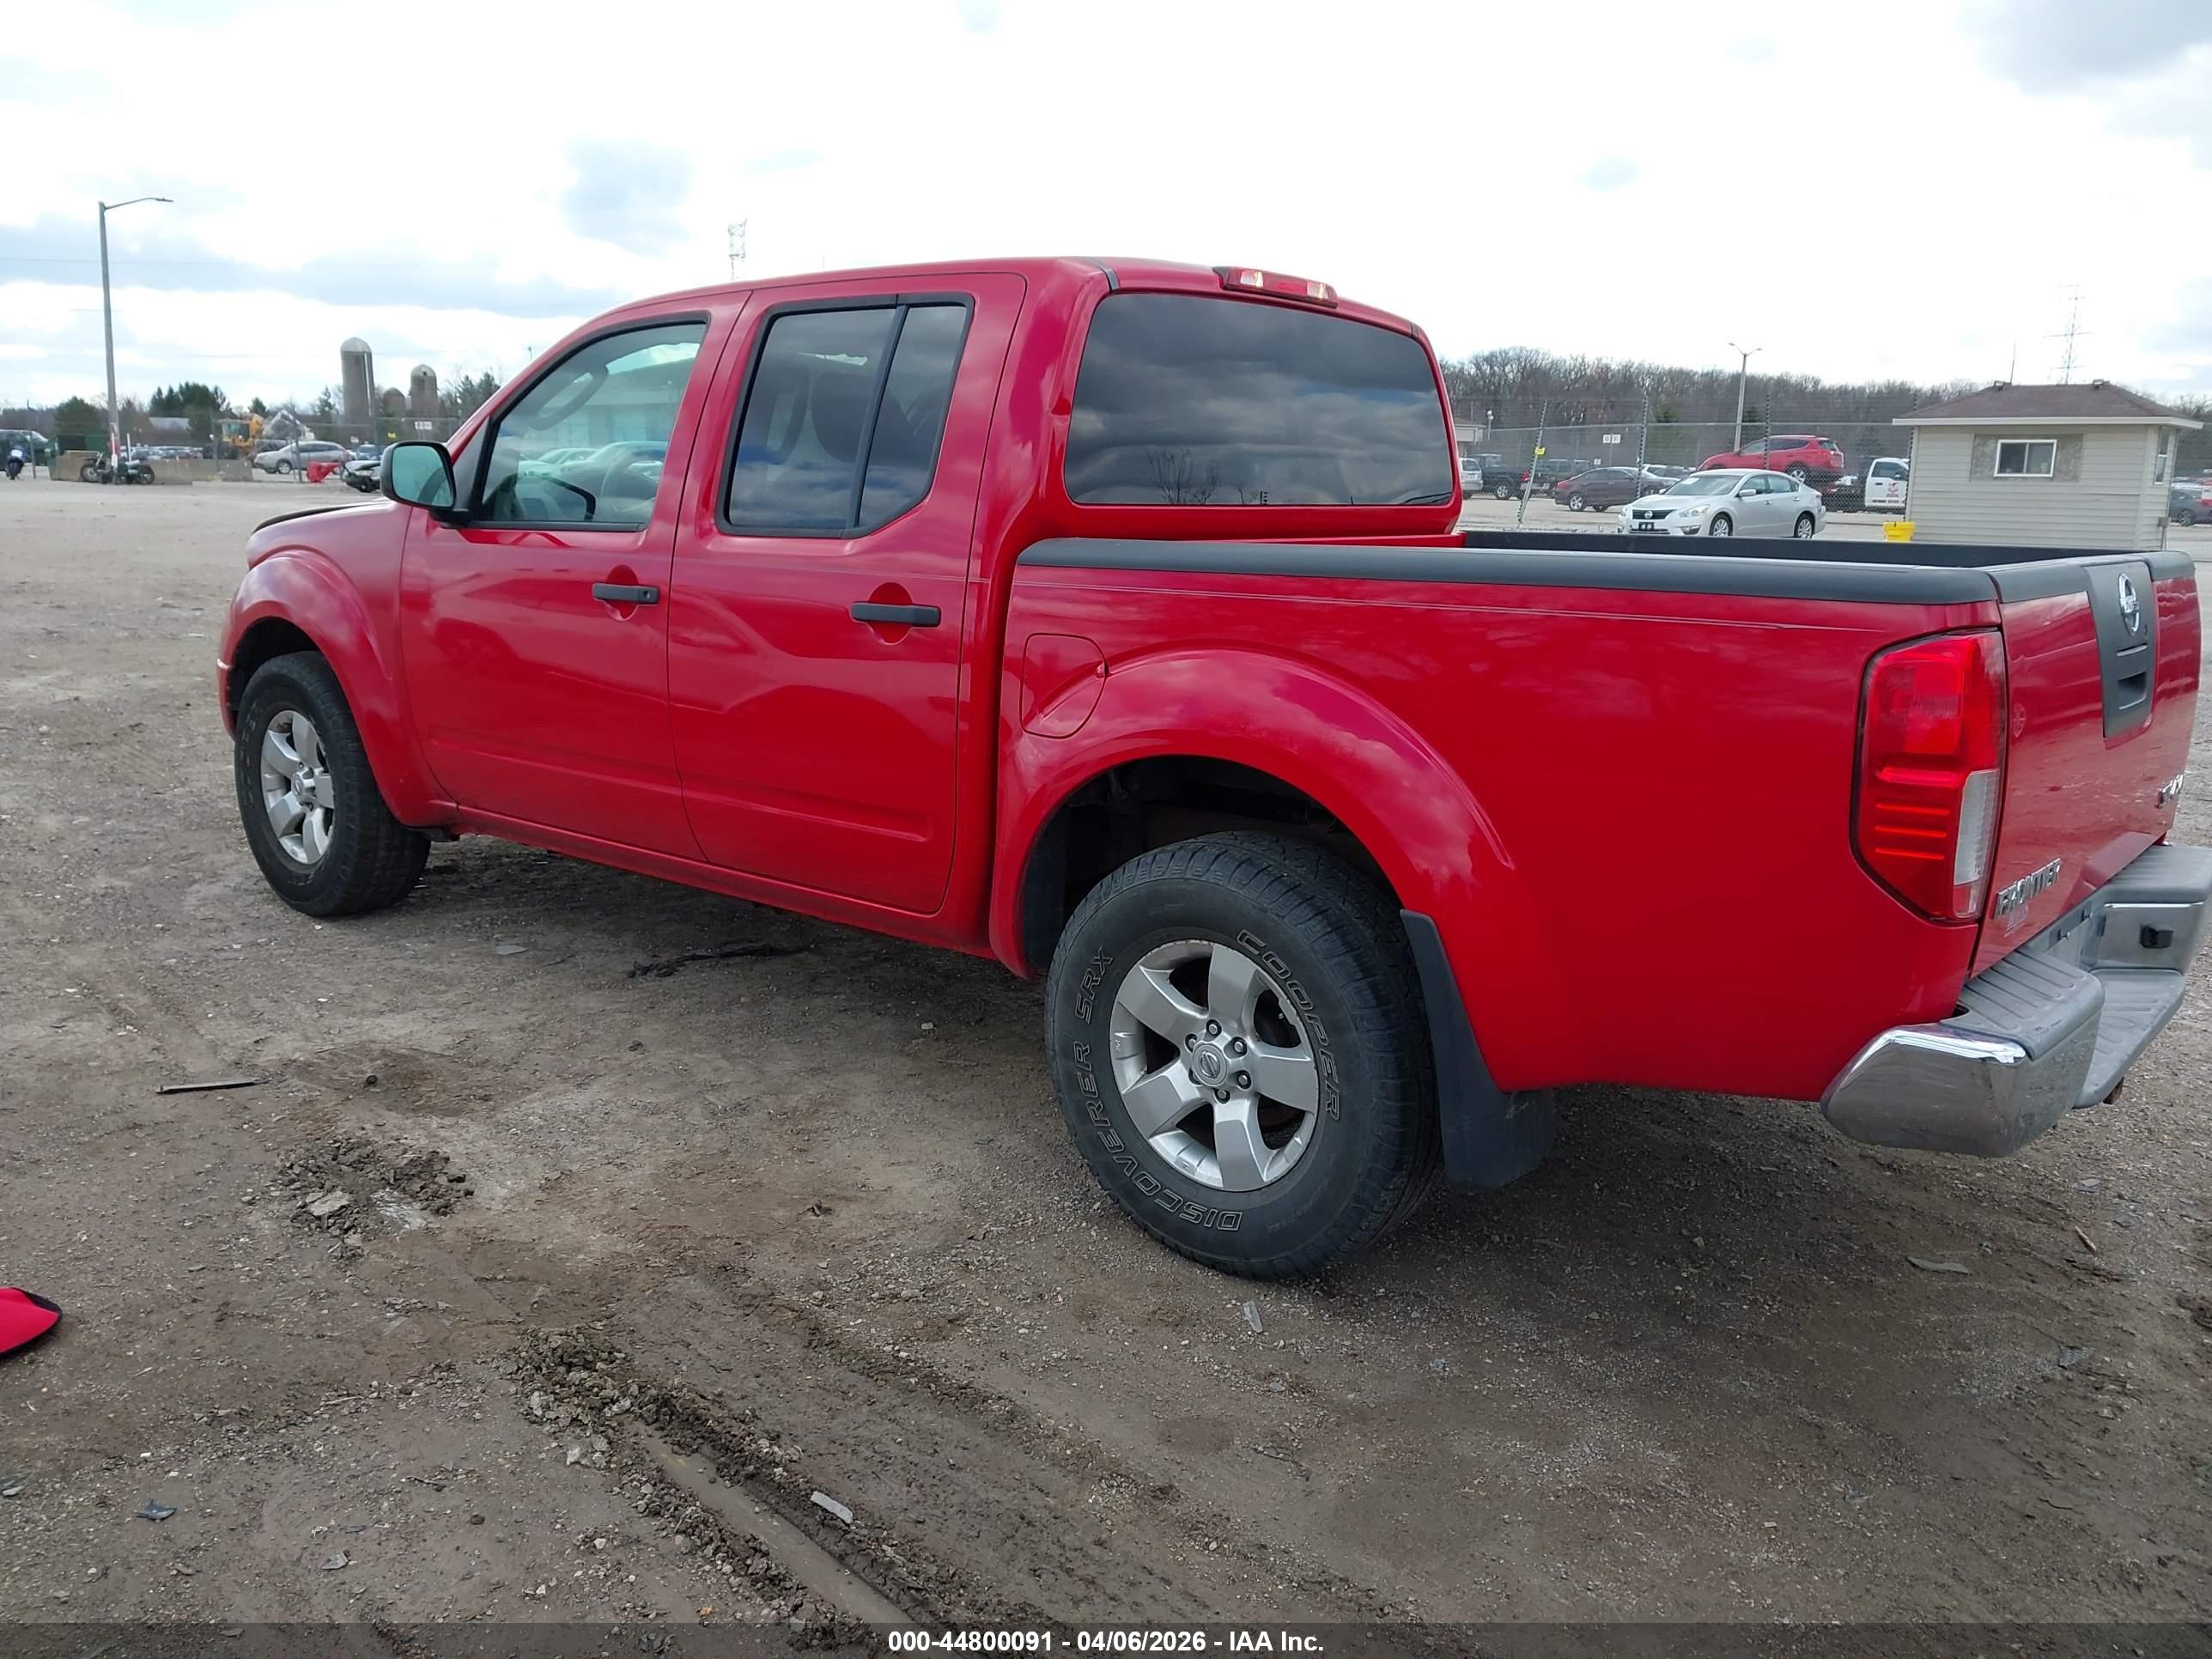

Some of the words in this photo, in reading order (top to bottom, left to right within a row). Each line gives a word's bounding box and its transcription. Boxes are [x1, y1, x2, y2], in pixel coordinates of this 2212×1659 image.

[1074, 945, 1114, 1024] SRX
[1236, 929, 1340, 1121] COOPER
[1073, 1040, 1243, 1232] DISCOVERER
